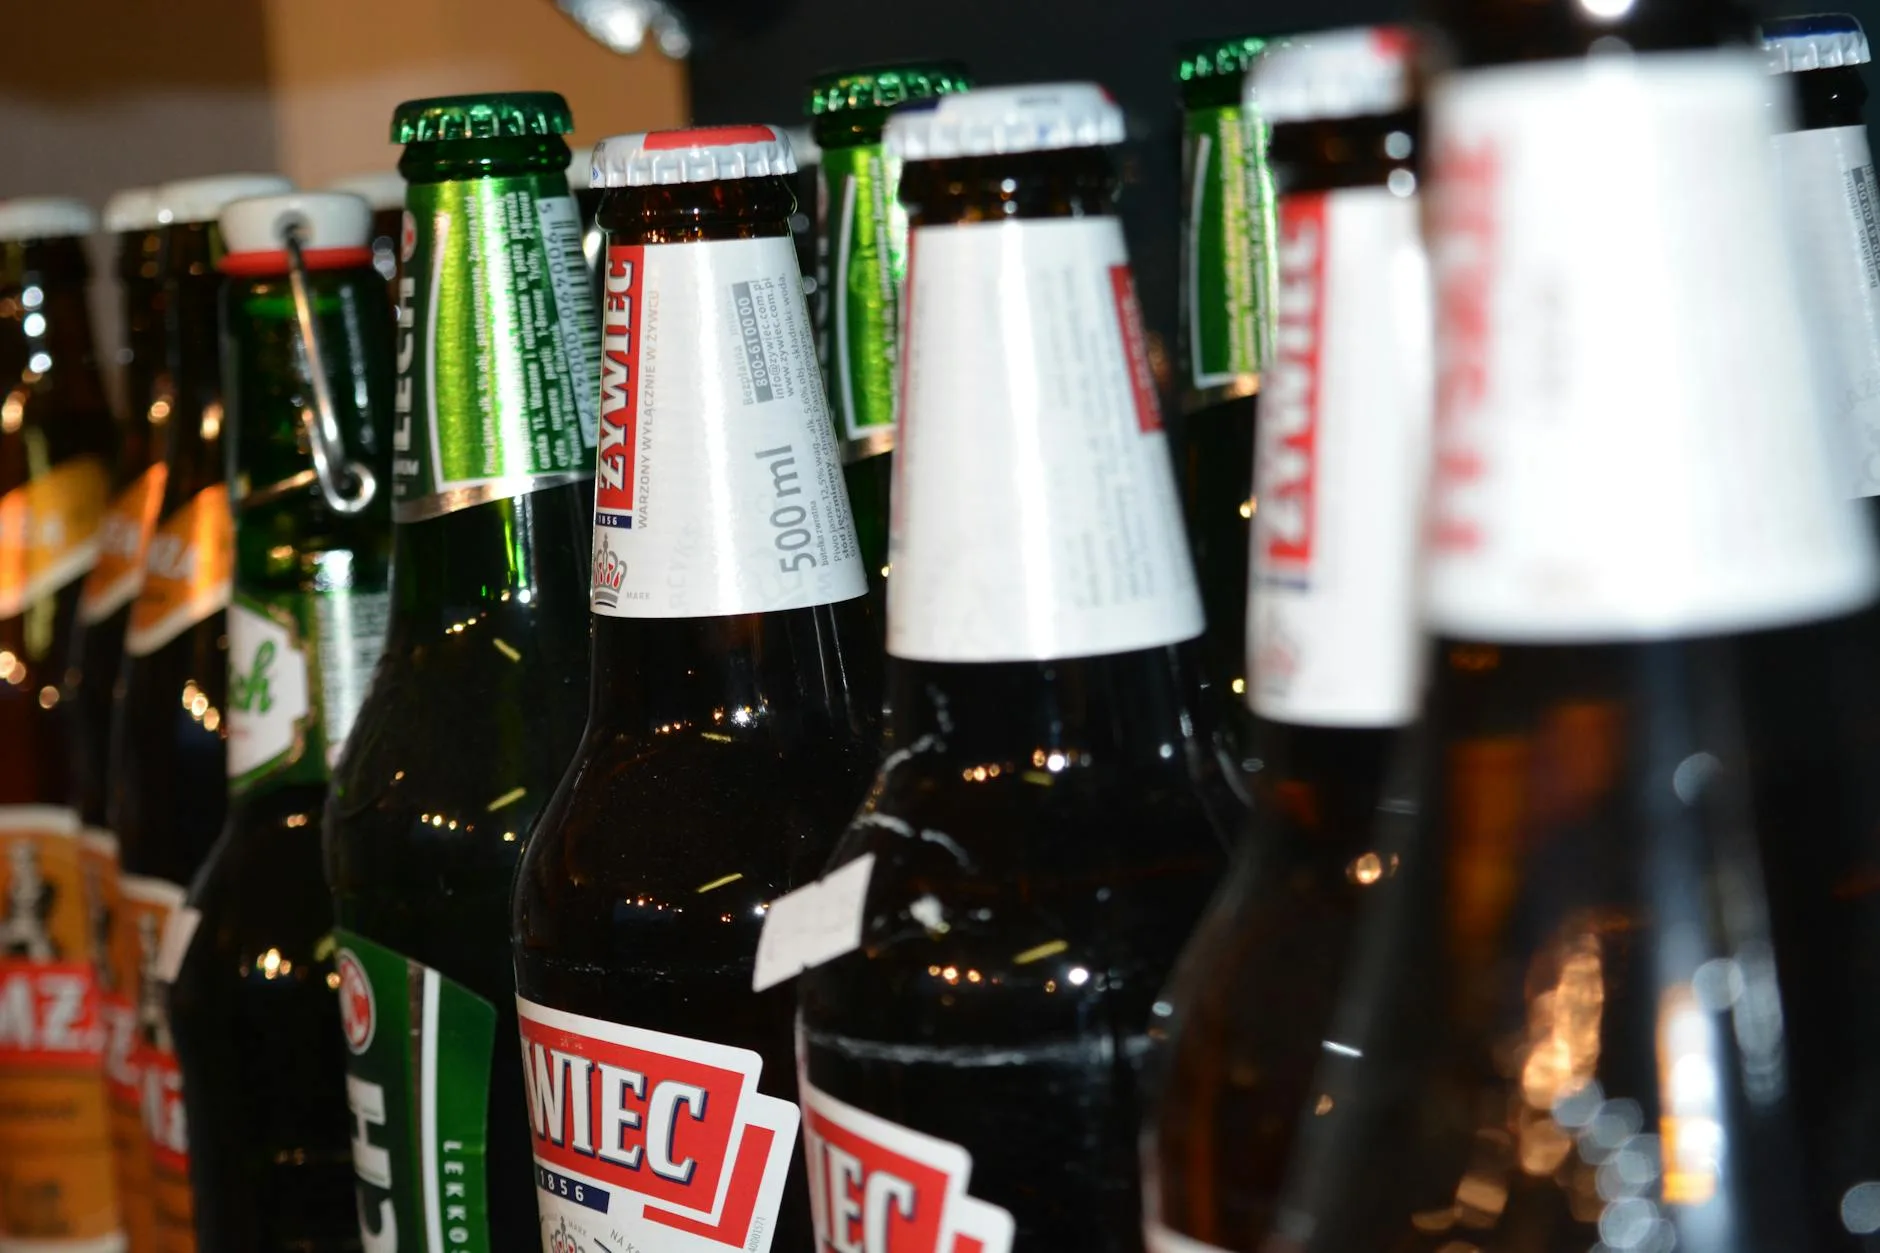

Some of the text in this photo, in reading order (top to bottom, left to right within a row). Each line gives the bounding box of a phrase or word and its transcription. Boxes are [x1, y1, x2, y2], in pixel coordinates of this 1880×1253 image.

[646, 344, 657, 362] W
[641, 366, 657, 451] WYŁĄCZNIE
[638, 455, 651, 530] WARZONY
[817, 467, 830, 501] 12,5%
[754, 445, 816, 574] 500 ml
[824, 501, 837, 534] jasne,
[810, 500, 830, 567] butelka zwrotna
[831, 535, 843, 563] Piwo
[443, 1141, 470, 1253] LEKKO
[539, 1170, 585, 1203] 1856
[610, 1228, 625, 1247] NA
